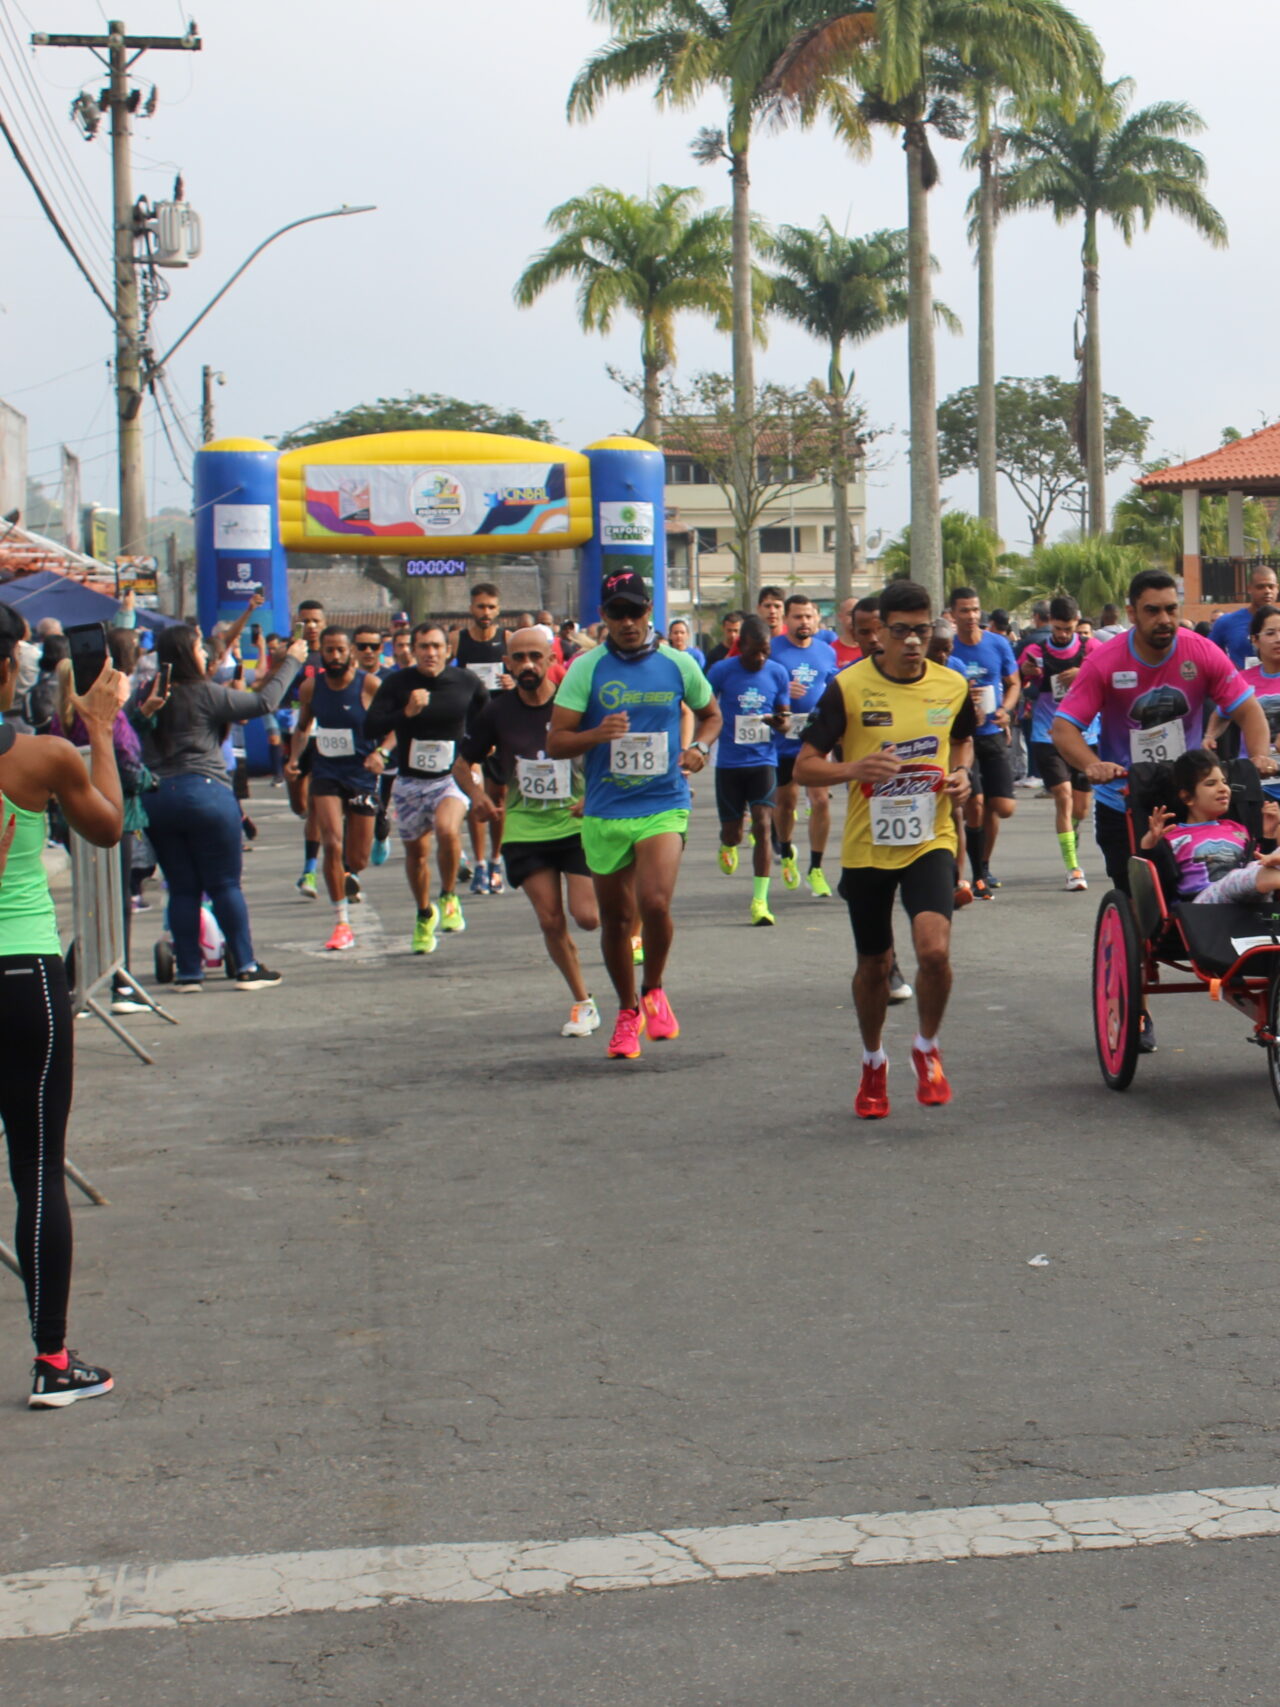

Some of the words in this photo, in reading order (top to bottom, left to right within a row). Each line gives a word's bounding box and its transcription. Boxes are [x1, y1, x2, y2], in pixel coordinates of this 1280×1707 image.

[739, 727, 763, 740] 391
[319, 736, 348, 750] 089
[417, 754, 437, 768] 85
[615, 751, 654, 770] 318
[1142, 745, 1167, 763] 39
[523, 777, 557, 794] 264
[876, 817, 922, 839] 203
